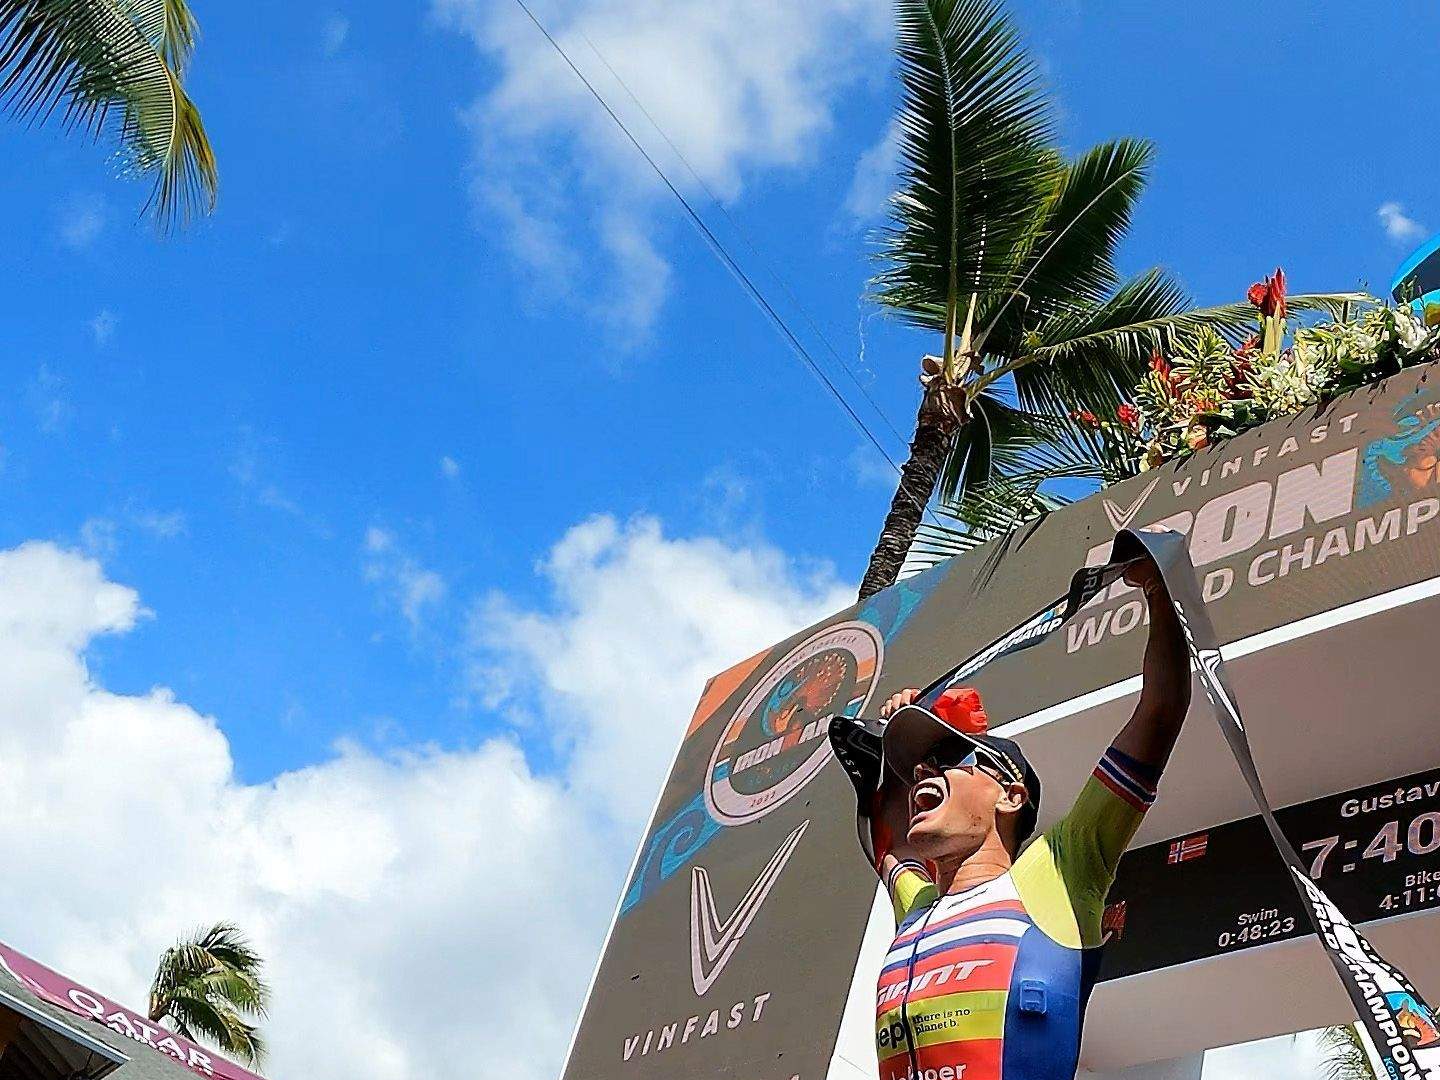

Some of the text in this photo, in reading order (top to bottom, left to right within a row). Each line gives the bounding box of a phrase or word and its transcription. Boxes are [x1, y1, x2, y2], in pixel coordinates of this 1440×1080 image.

[1172, 411, 1360, 499] VINFAST
[1081, 446, 1359, 607] ON
[1066, 567, 1235, 654] WOD
[1340, 777, 1440, 820] Gustav
[1218, 916, 1295, 949] 0:48:23
[1237, 906, 1279, 927] Swim
[67, 988, 214, 1076] QATAR
[622, 991, 772, 1062] VINFAST
[943, 1010, 953, 1018] is
[955, 1008, 971, 1017] no
